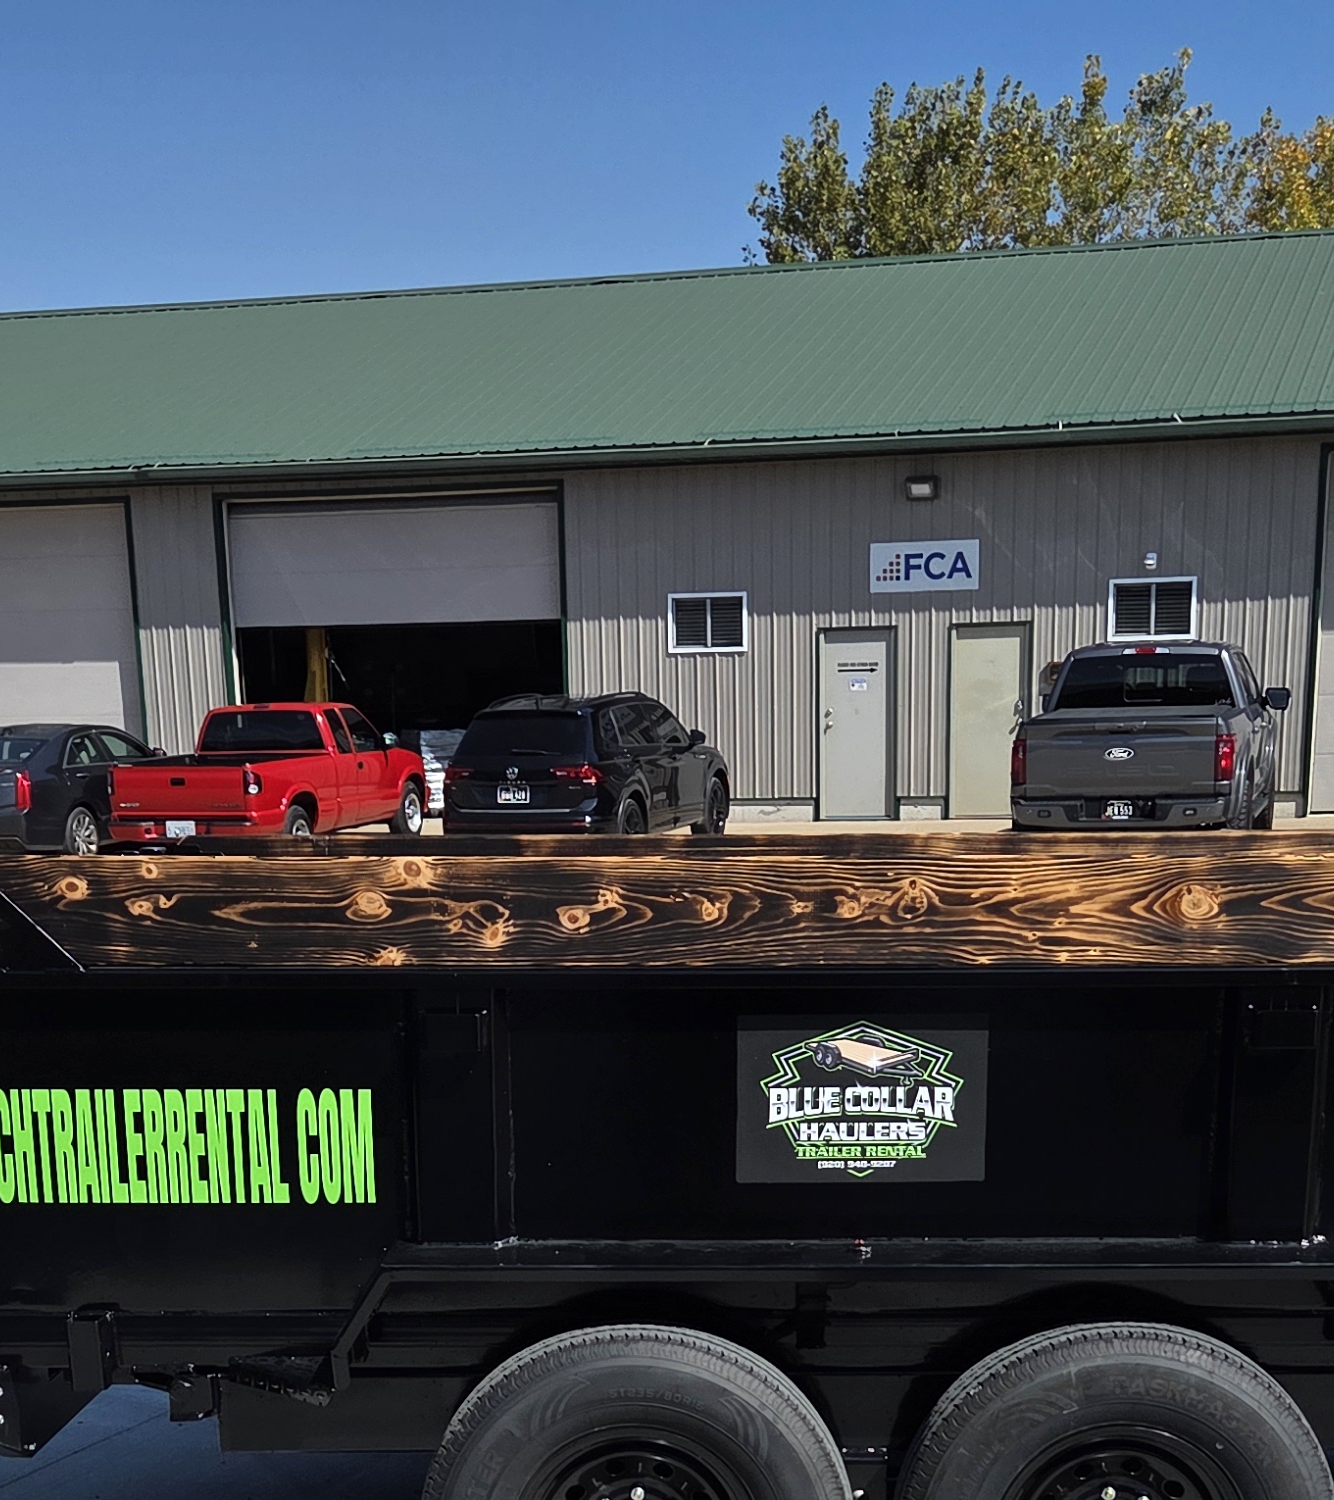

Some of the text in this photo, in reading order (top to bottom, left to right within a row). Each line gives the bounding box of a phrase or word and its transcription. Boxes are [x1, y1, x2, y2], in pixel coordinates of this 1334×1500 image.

[903, 551, 973, 581] FCA
[769, 1085, 955, 1124] BLUE COLLAR
[799, 1122, 927, 1142] HAULERS
[797, 1145, 927, 1158] TRAILER RENTAL
